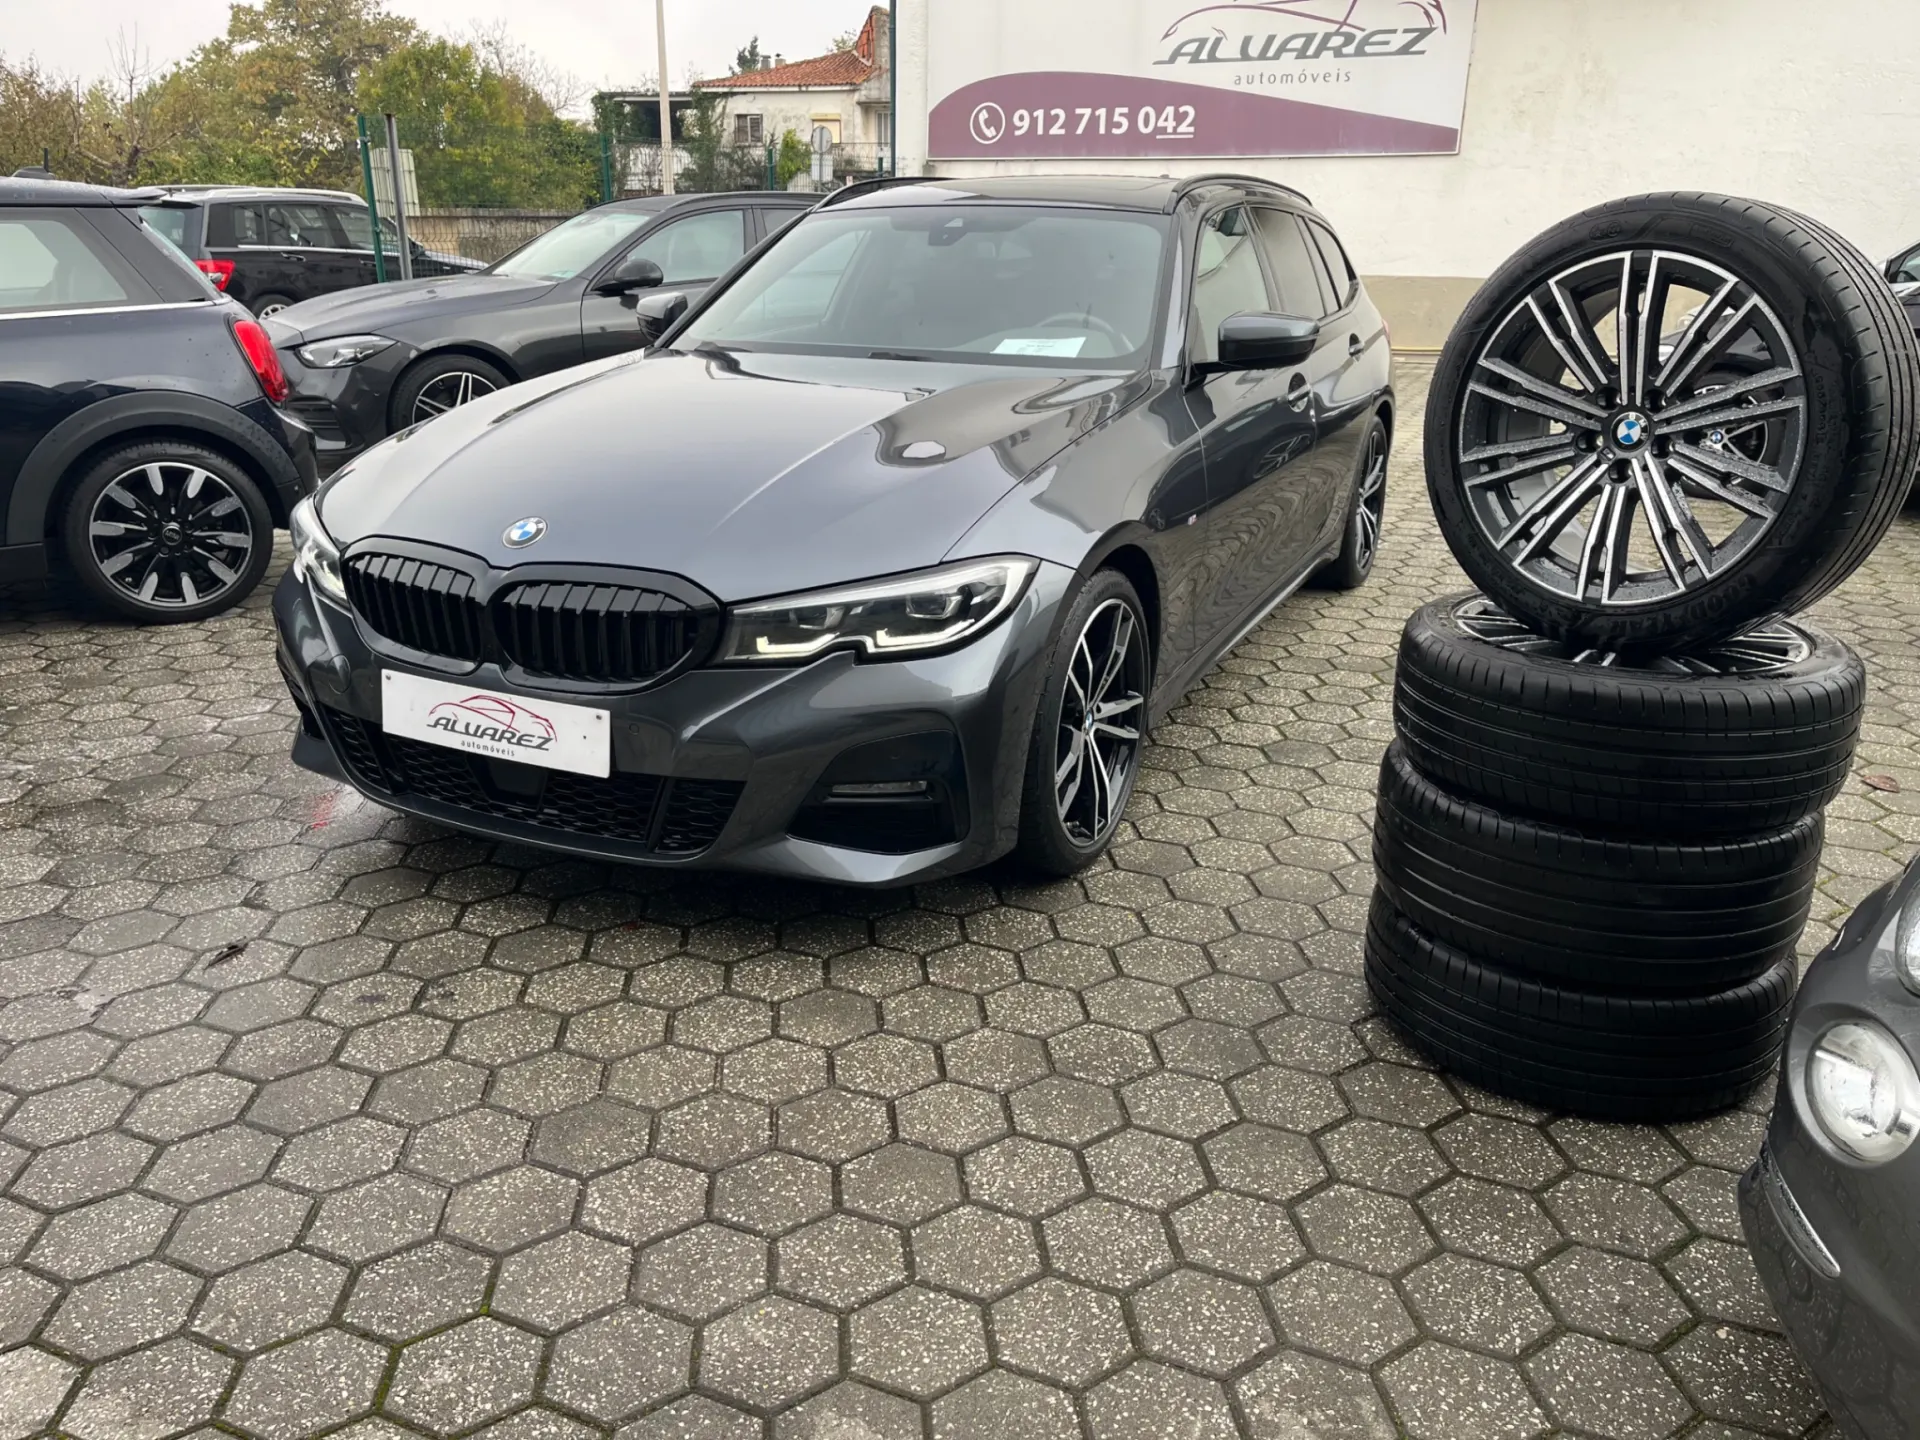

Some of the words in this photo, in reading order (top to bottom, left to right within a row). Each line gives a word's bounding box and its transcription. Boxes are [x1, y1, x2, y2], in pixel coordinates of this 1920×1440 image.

[1152, 26, 1438, 65] ALVAREZ
[1234, 68, 1352, 86] automóveis
[1012, 108, 1066, 136] 912
[1075, 106, 1129, 135] 715
[1136, 105, 1196, 136] 042
[426, 716, 554, 752] ALVAREZ
[460, 739, 516, 757] automóveis
